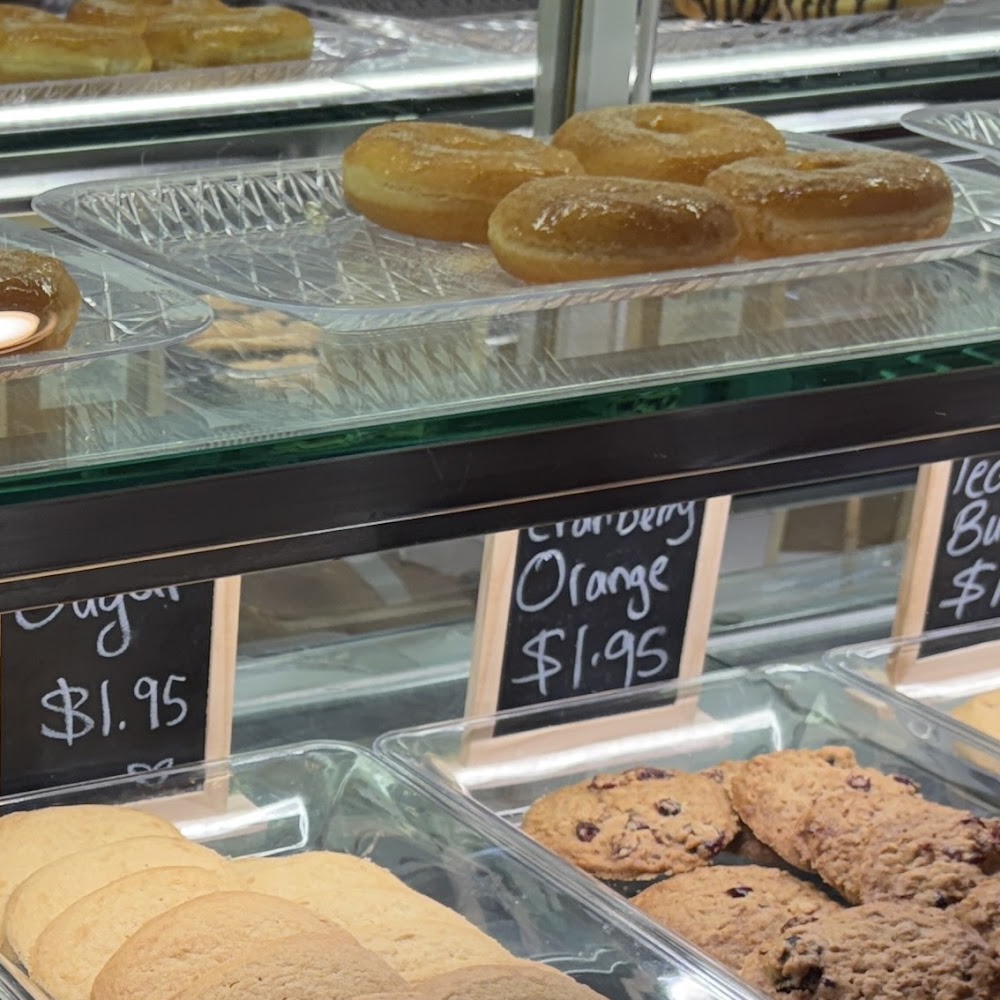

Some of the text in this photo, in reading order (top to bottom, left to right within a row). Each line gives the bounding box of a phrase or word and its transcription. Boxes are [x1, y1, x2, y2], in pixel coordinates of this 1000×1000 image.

[516, 549, 669, 620] Orange
[511, 624, 668, 696] $1.95
[40, 675, 187, 746] $1.95
